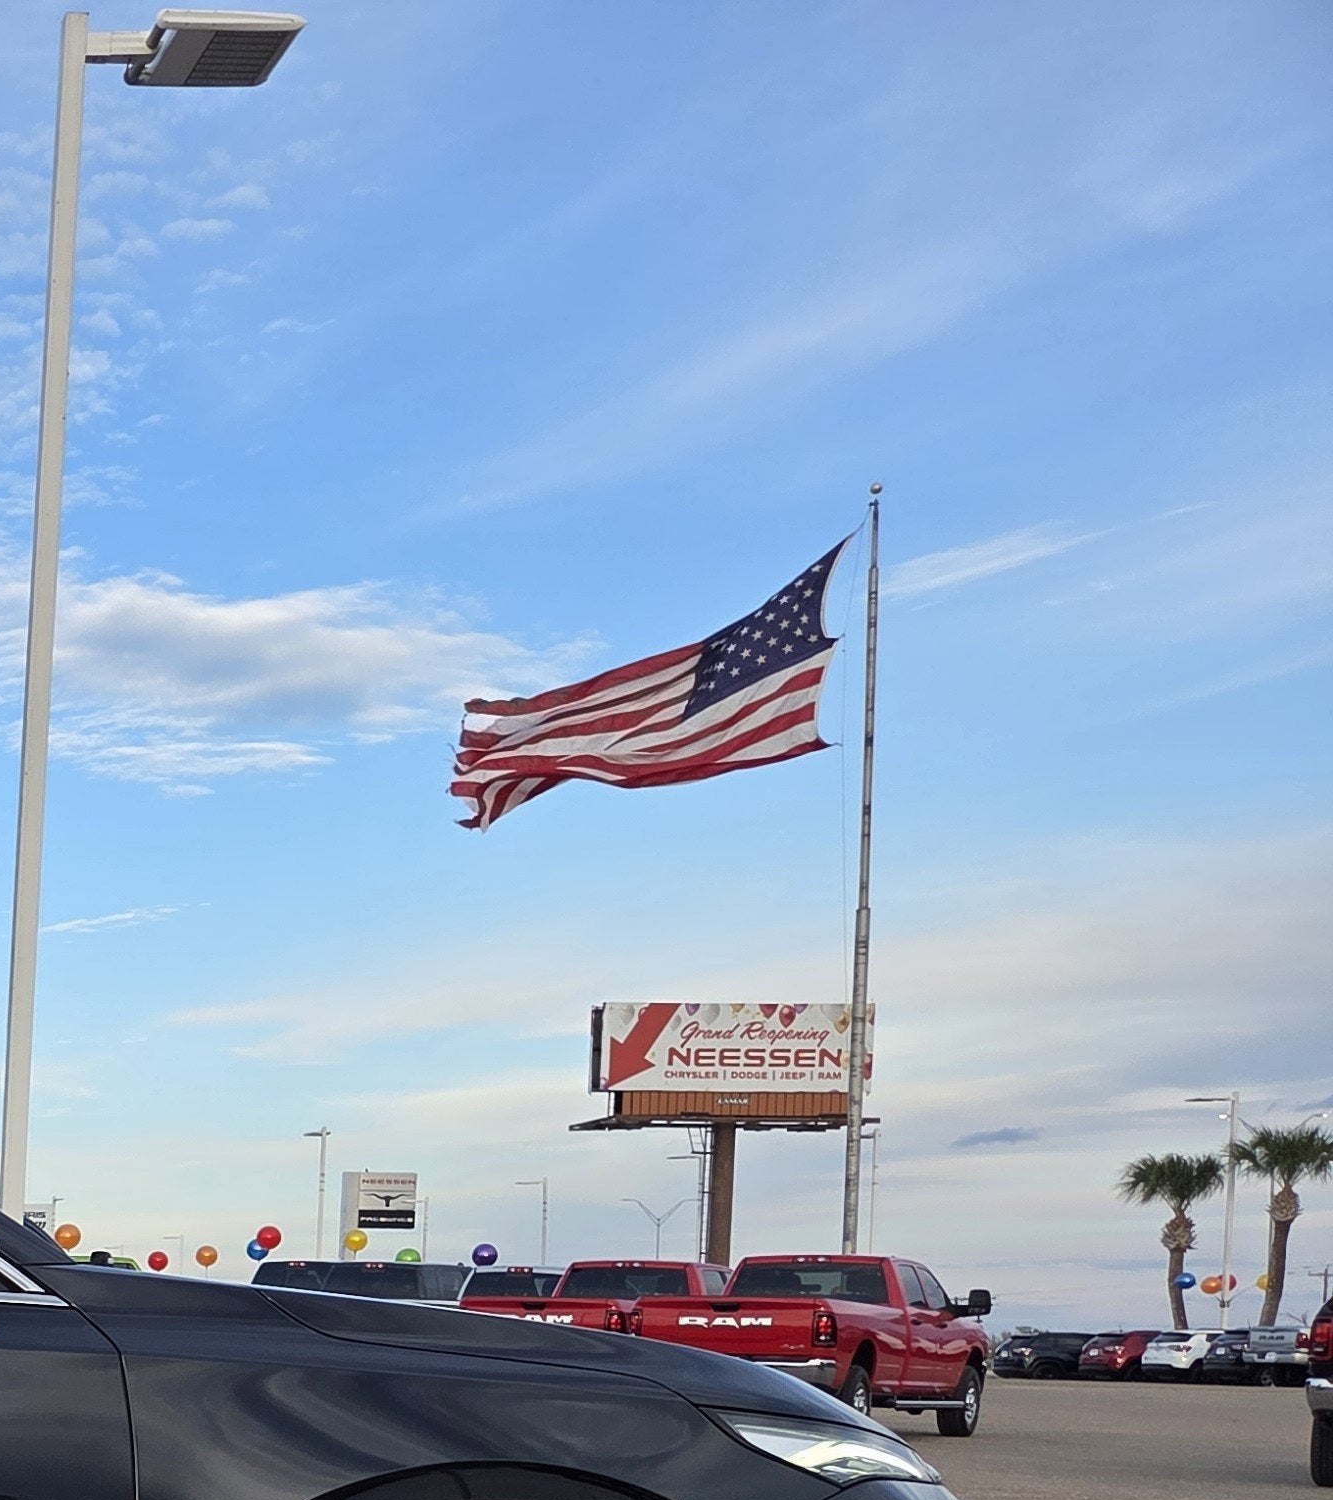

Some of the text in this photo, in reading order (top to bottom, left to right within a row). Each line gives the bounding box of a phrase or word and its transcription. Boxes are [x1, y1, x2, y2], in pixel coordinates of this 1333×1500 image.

[680, 1021, 830, 1048] Grand Reopening
[667, 1046, 843, 1067] NEESSEN
[664, 1071, 842, 1080] CHRYSLER DODGE JEEP RAM
[678, 1316, 773, 1329] RAM
